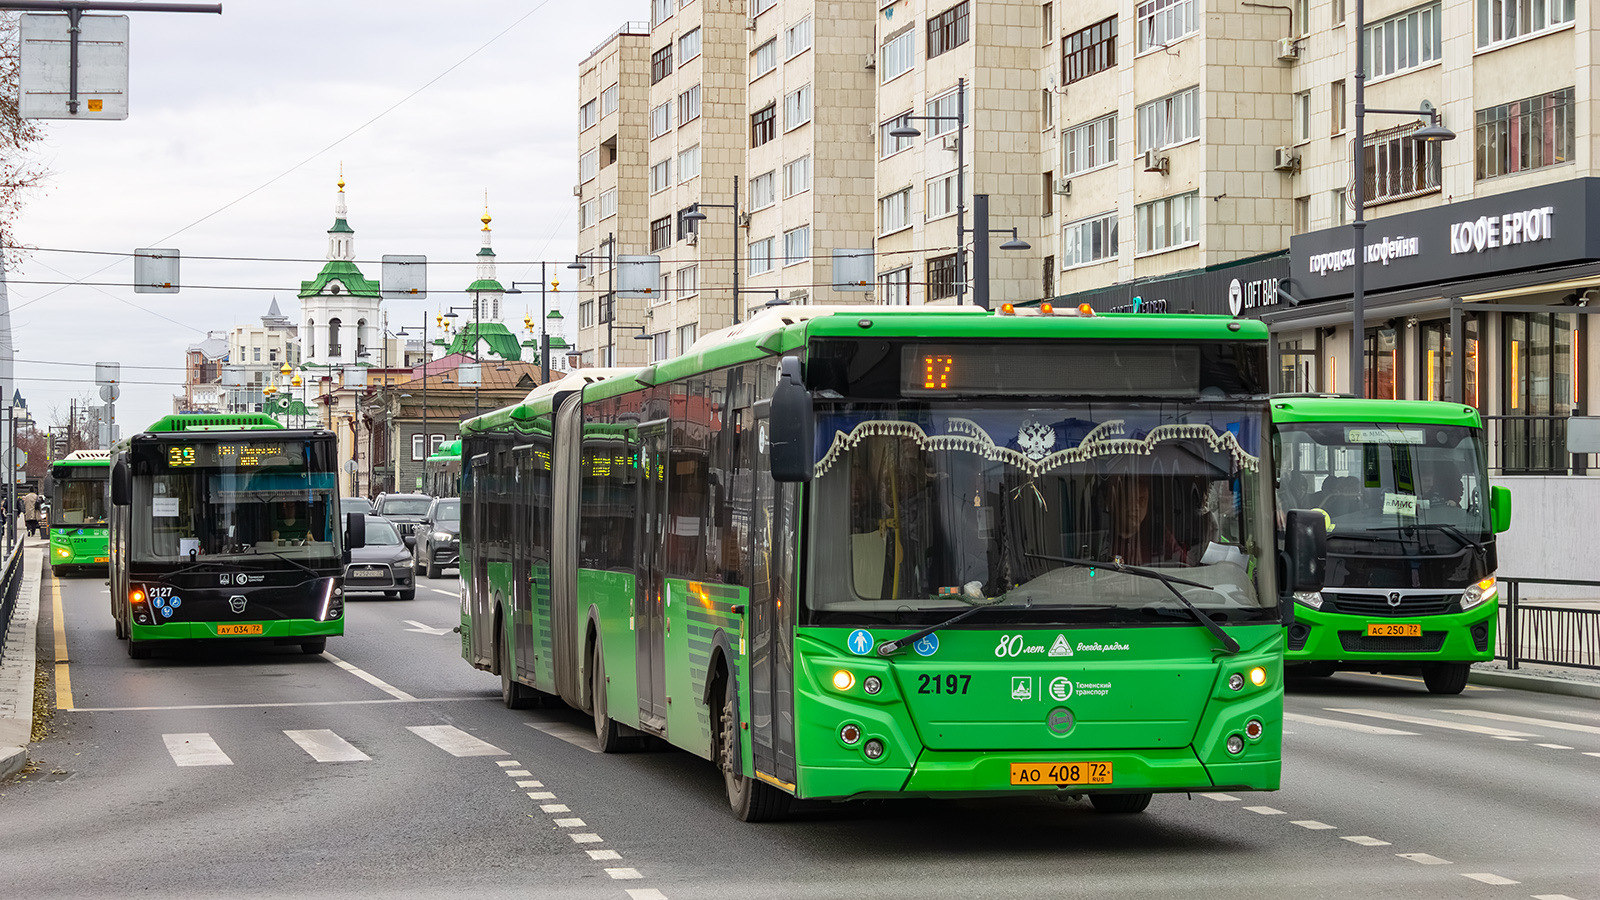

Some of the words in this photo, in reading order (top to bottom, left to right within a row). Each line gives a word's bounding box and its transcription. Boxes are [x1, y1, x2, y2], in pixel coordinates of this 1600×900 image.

[1450, 215, 1500, 254] КОФЕ
[1502, 206, 1553, 246] БРЮТ
[1309, 247, 1367, 276] городск
[1367, 235, 1419, 266] кофейня
[1244, 280, 1261, 309] LOFT
[1263, 278, 1278, 306] BAR
[924, 354, 953, 389] 17
[169, 447, 196, 467] 39
[149, 587, 172, 597] 2127
[1372, 627, 1383, 635] АС
[1387, 625, 1404, 635] 250
[1409, 625, 1418, 633] 72
[994, 634, 1024, 658] 80
[1023, 644, 1045, 653] лет
[1076, 642, 1102, 652] Всегда
[1102, 641, 1130, 653] рядом
[917, 673, 972, 695] 2197
[1019, 769, 1041, 782] АО
[1048, 765, 1080, 782] 408
[1090, 764, 1107, 777] 72
